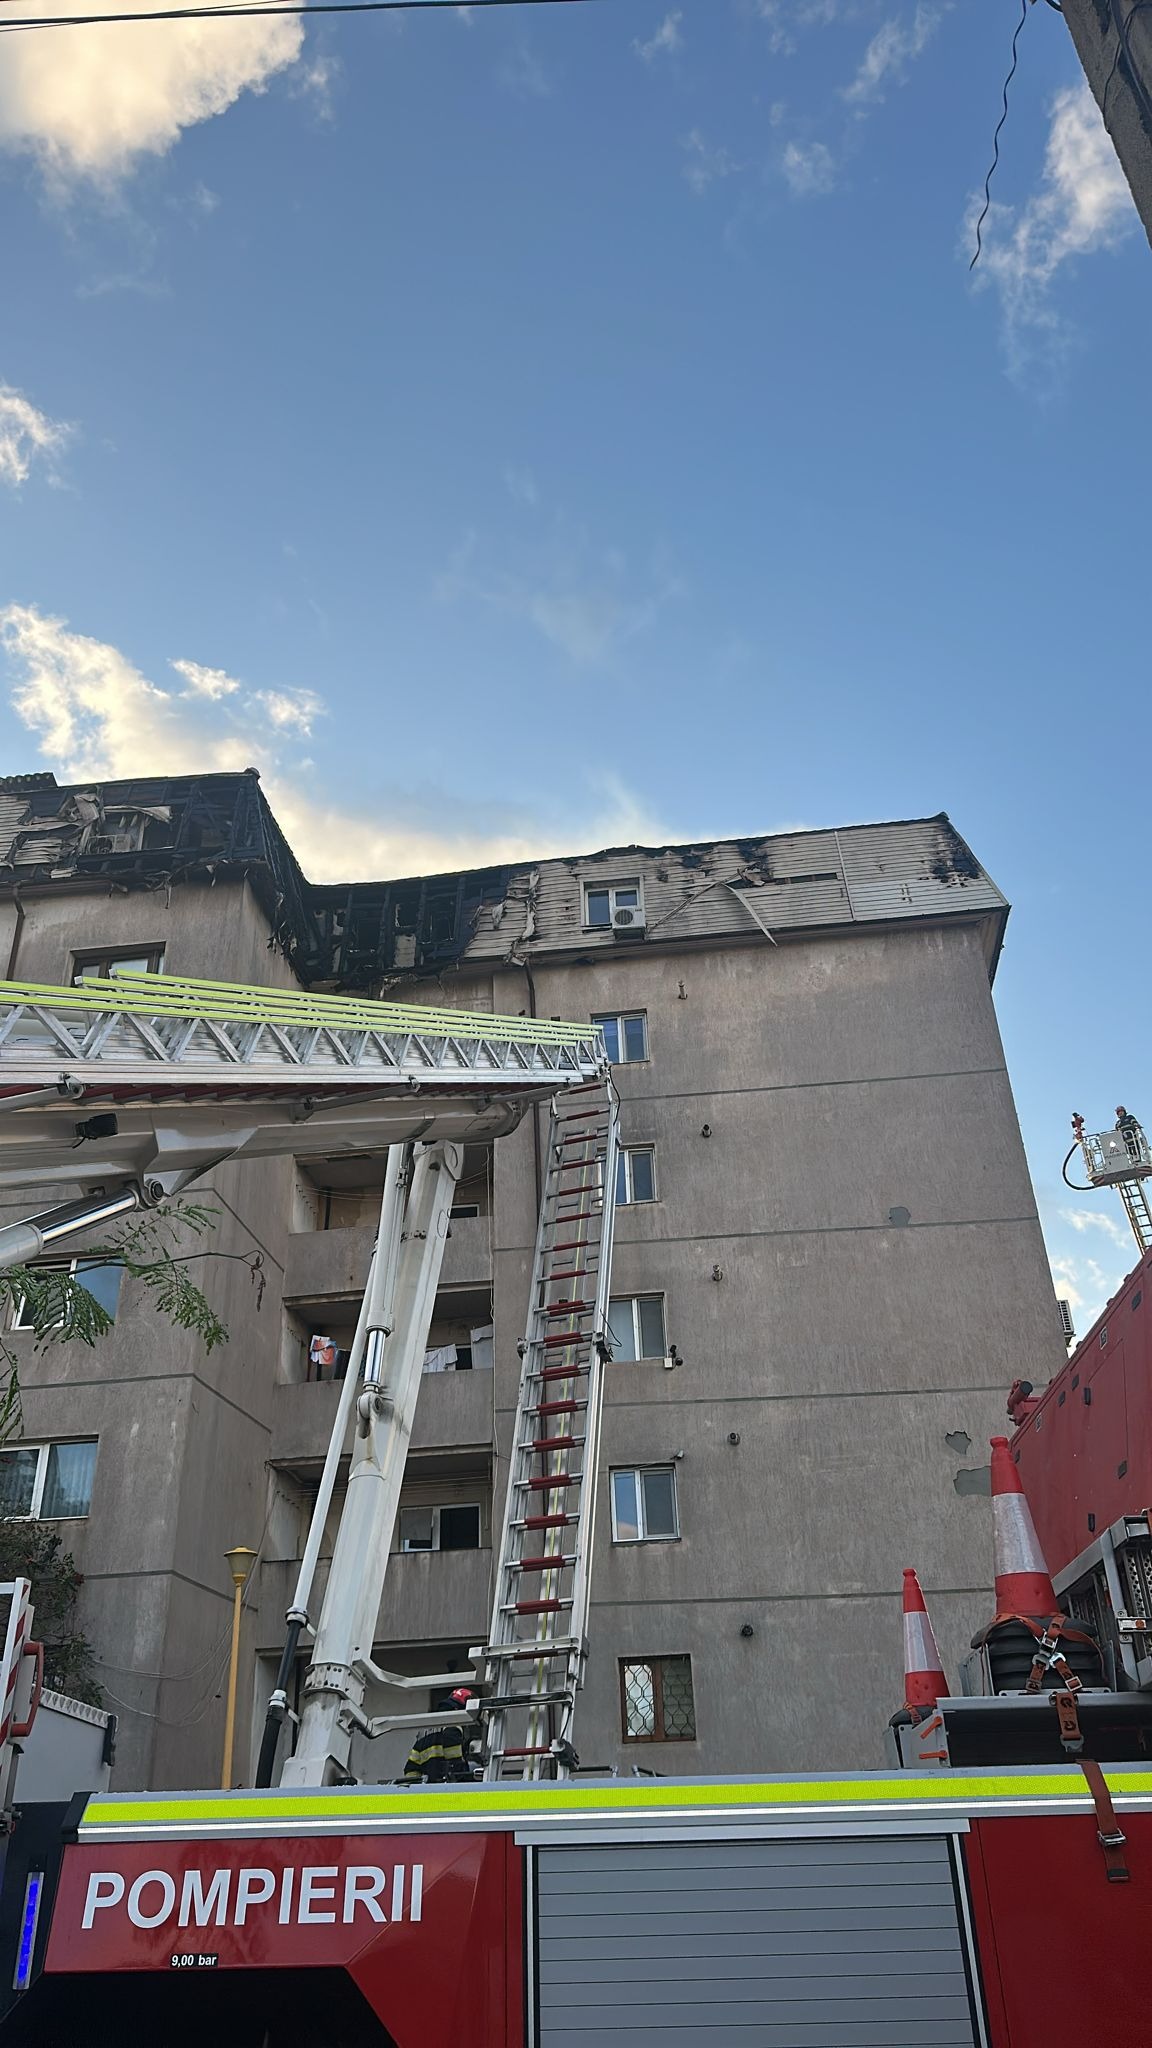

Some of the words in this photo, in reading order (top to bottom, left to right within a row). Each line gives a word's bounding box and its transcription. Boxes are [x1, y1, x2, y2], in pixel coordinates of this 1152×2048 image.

[81, 1864, 424, 1929] POMPIERII
[171, 1954, 194, 1968] 9,00
[198, 1954, 217, 1966] bar
